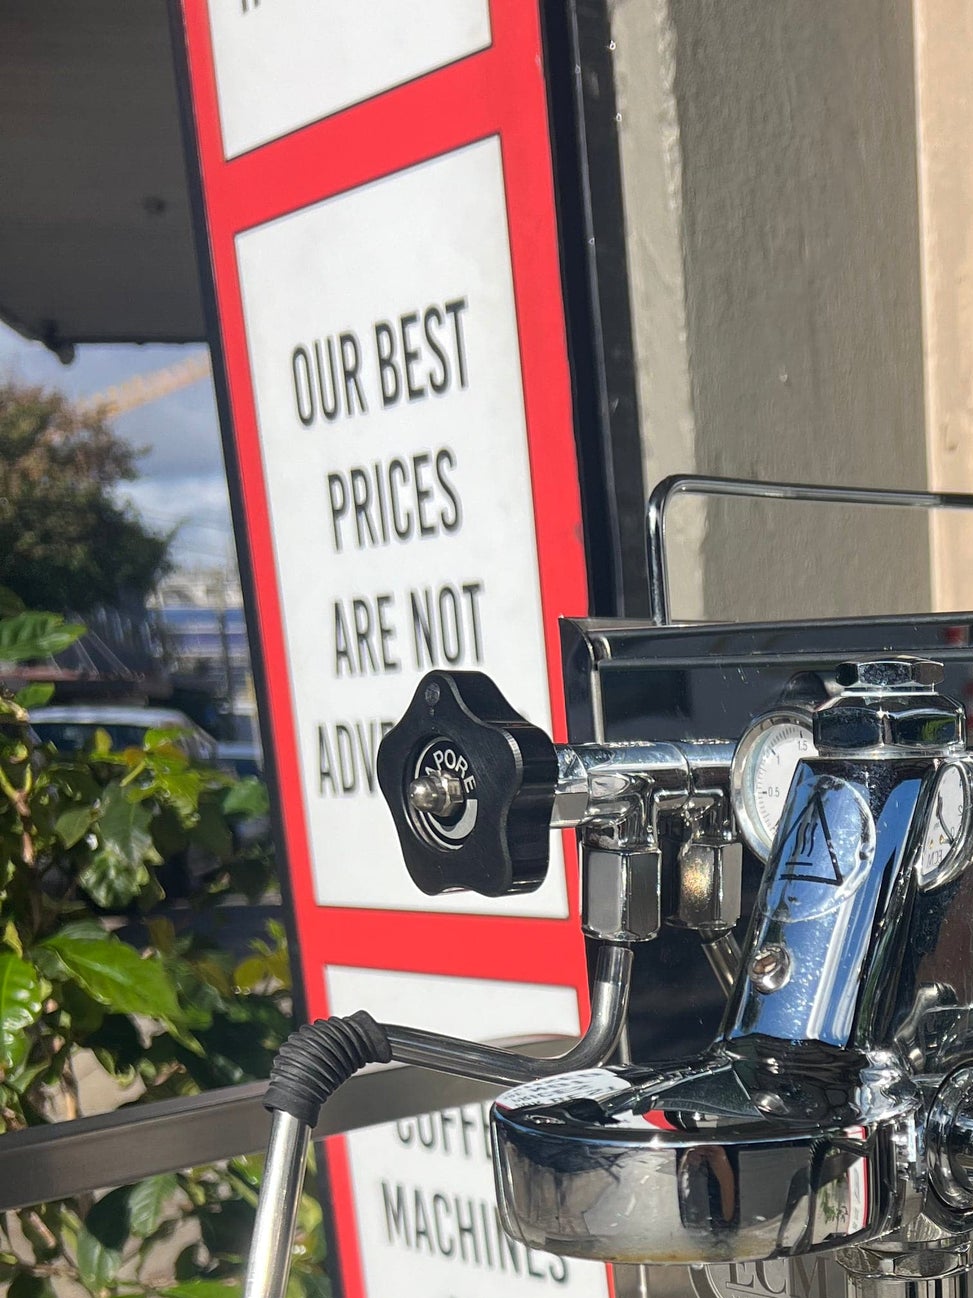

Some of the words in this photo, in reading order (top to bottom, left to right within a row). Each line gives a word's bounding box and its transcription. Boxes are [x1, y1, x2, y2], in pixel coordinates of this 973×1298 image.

[292, 332, 367, 427] OUR
[374, 299, 468, 409] BEST
[326, 448, 463, 553] PRICES
[333, 595, 399, 677] ARE
[410, 581, 483, 668] NOT
[425, 749, 476, 793] PORE
